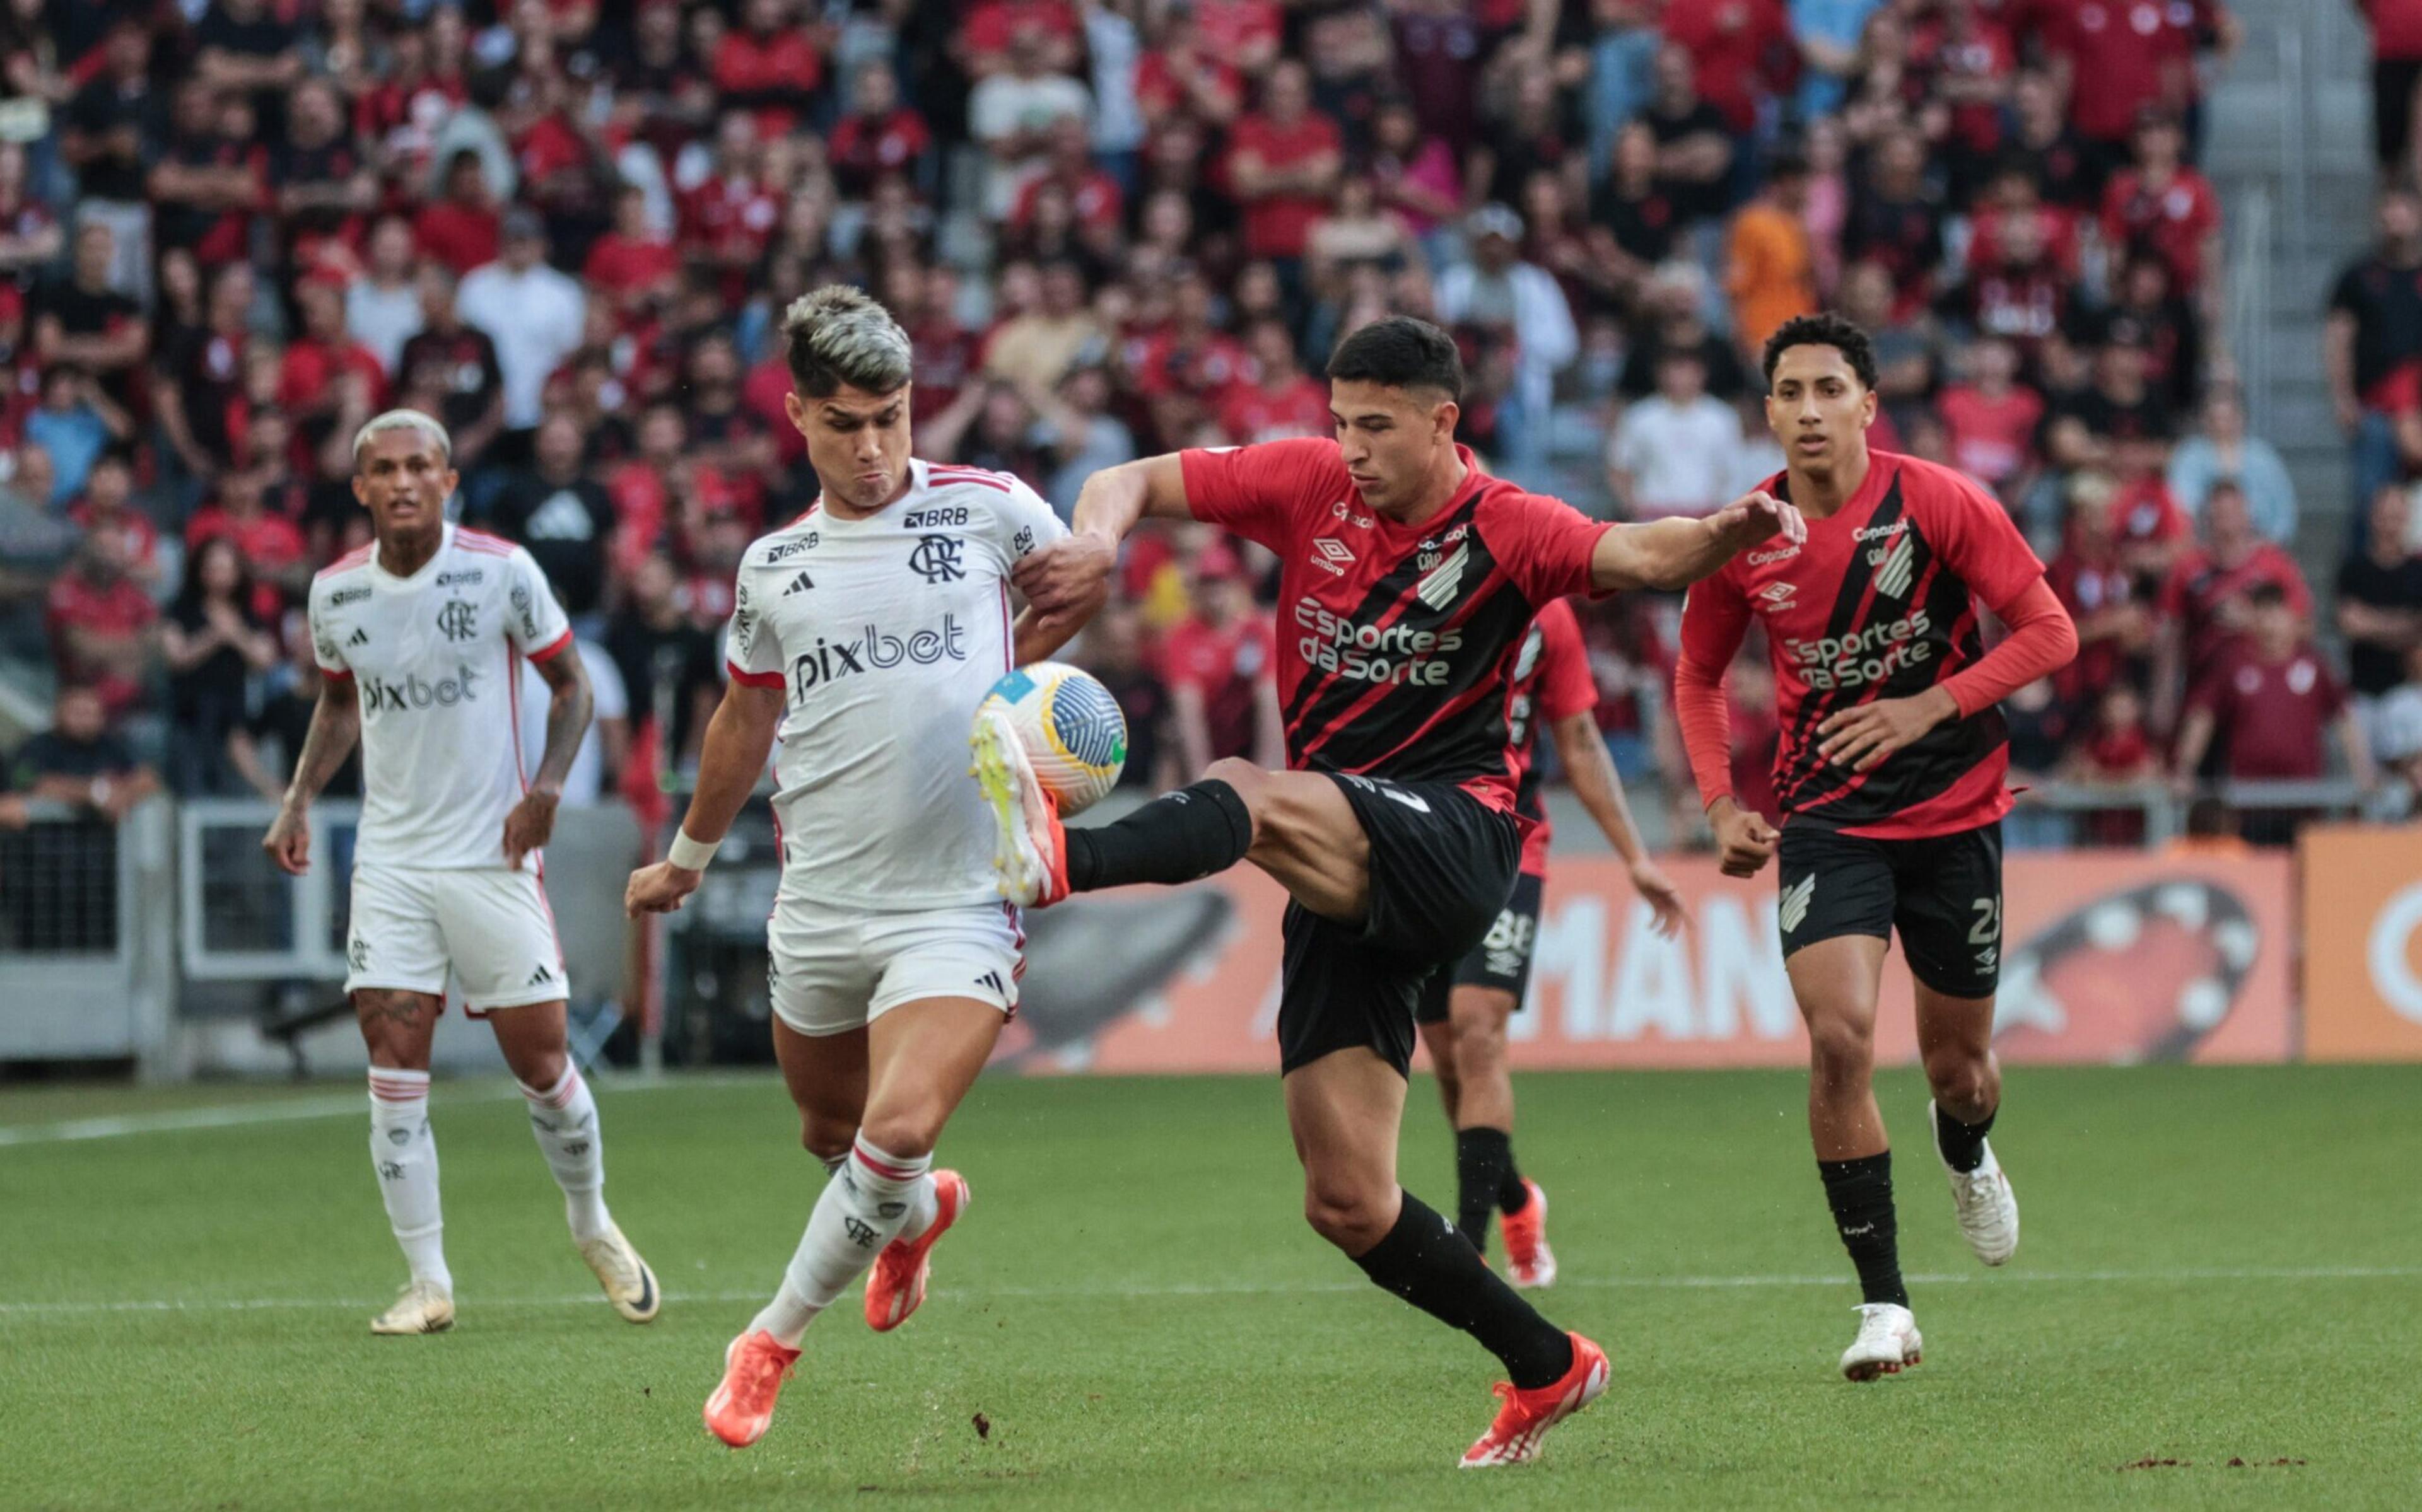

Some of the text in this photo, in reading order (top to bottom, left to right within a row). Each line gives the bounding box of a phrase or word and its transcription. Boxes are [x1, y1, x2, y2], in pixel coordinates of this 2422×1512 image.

[925, 507, 968, 526] BRB
[1852, 517, 1909, 542] Copacol
[784, 532, 819, 556] BRB
[1747, 545, 1801, 566] Copacol
[1311, 554, 1345, 576] umbro
[1296, 597, 1463, 654] Esportes
[796, 614, 966, 704] pixbet
[363, 662, 477, 719] pixbet
